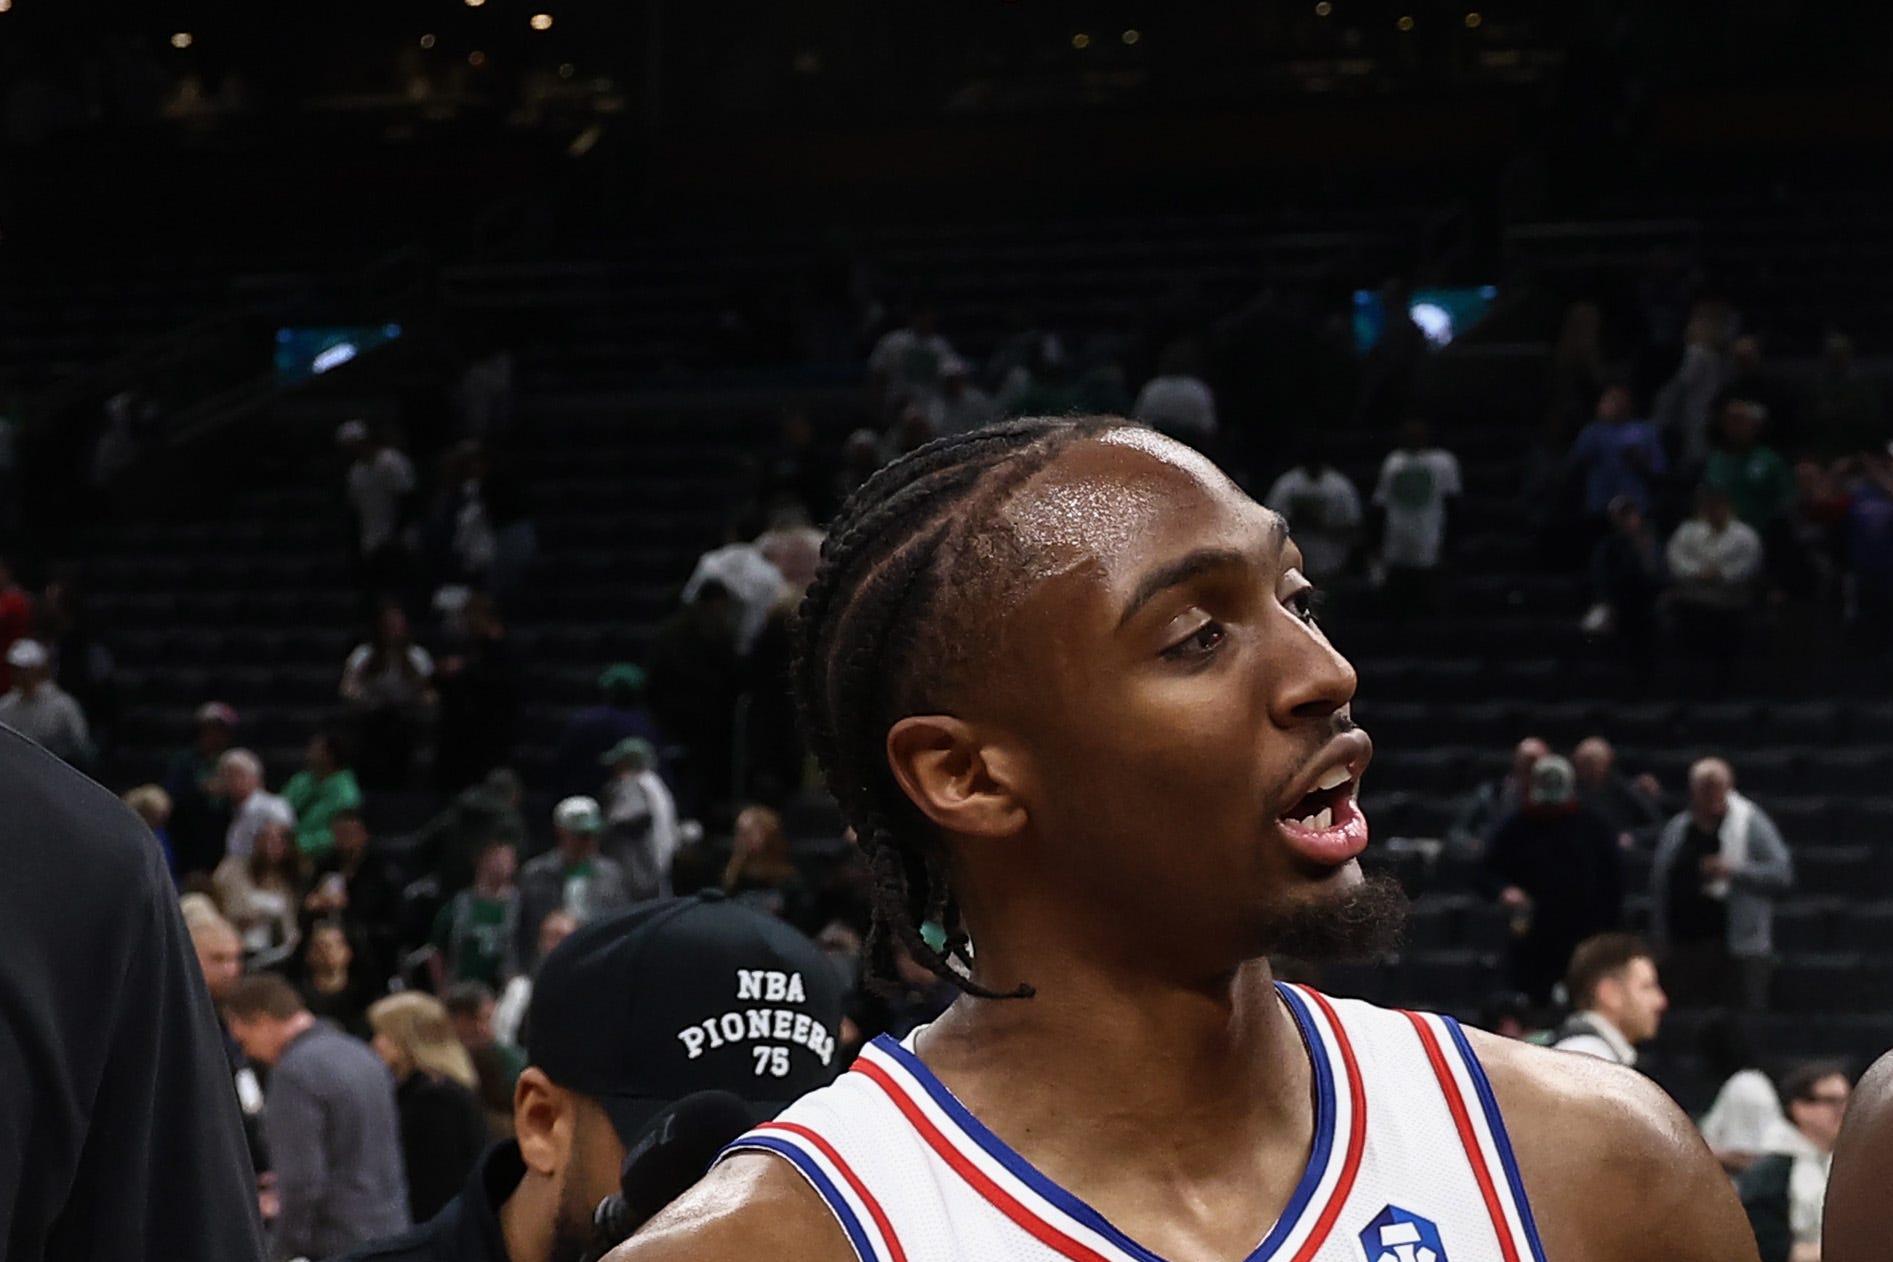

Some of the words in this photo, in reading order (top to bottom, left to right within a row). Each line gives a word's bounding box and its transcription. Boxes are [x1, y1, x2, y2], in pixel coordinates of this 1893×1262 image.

[737, 969, 806, 1003] NBA
[677, 1008, 835, 1066] PIONEERS
[753, 1045, 790, 1077] 75
